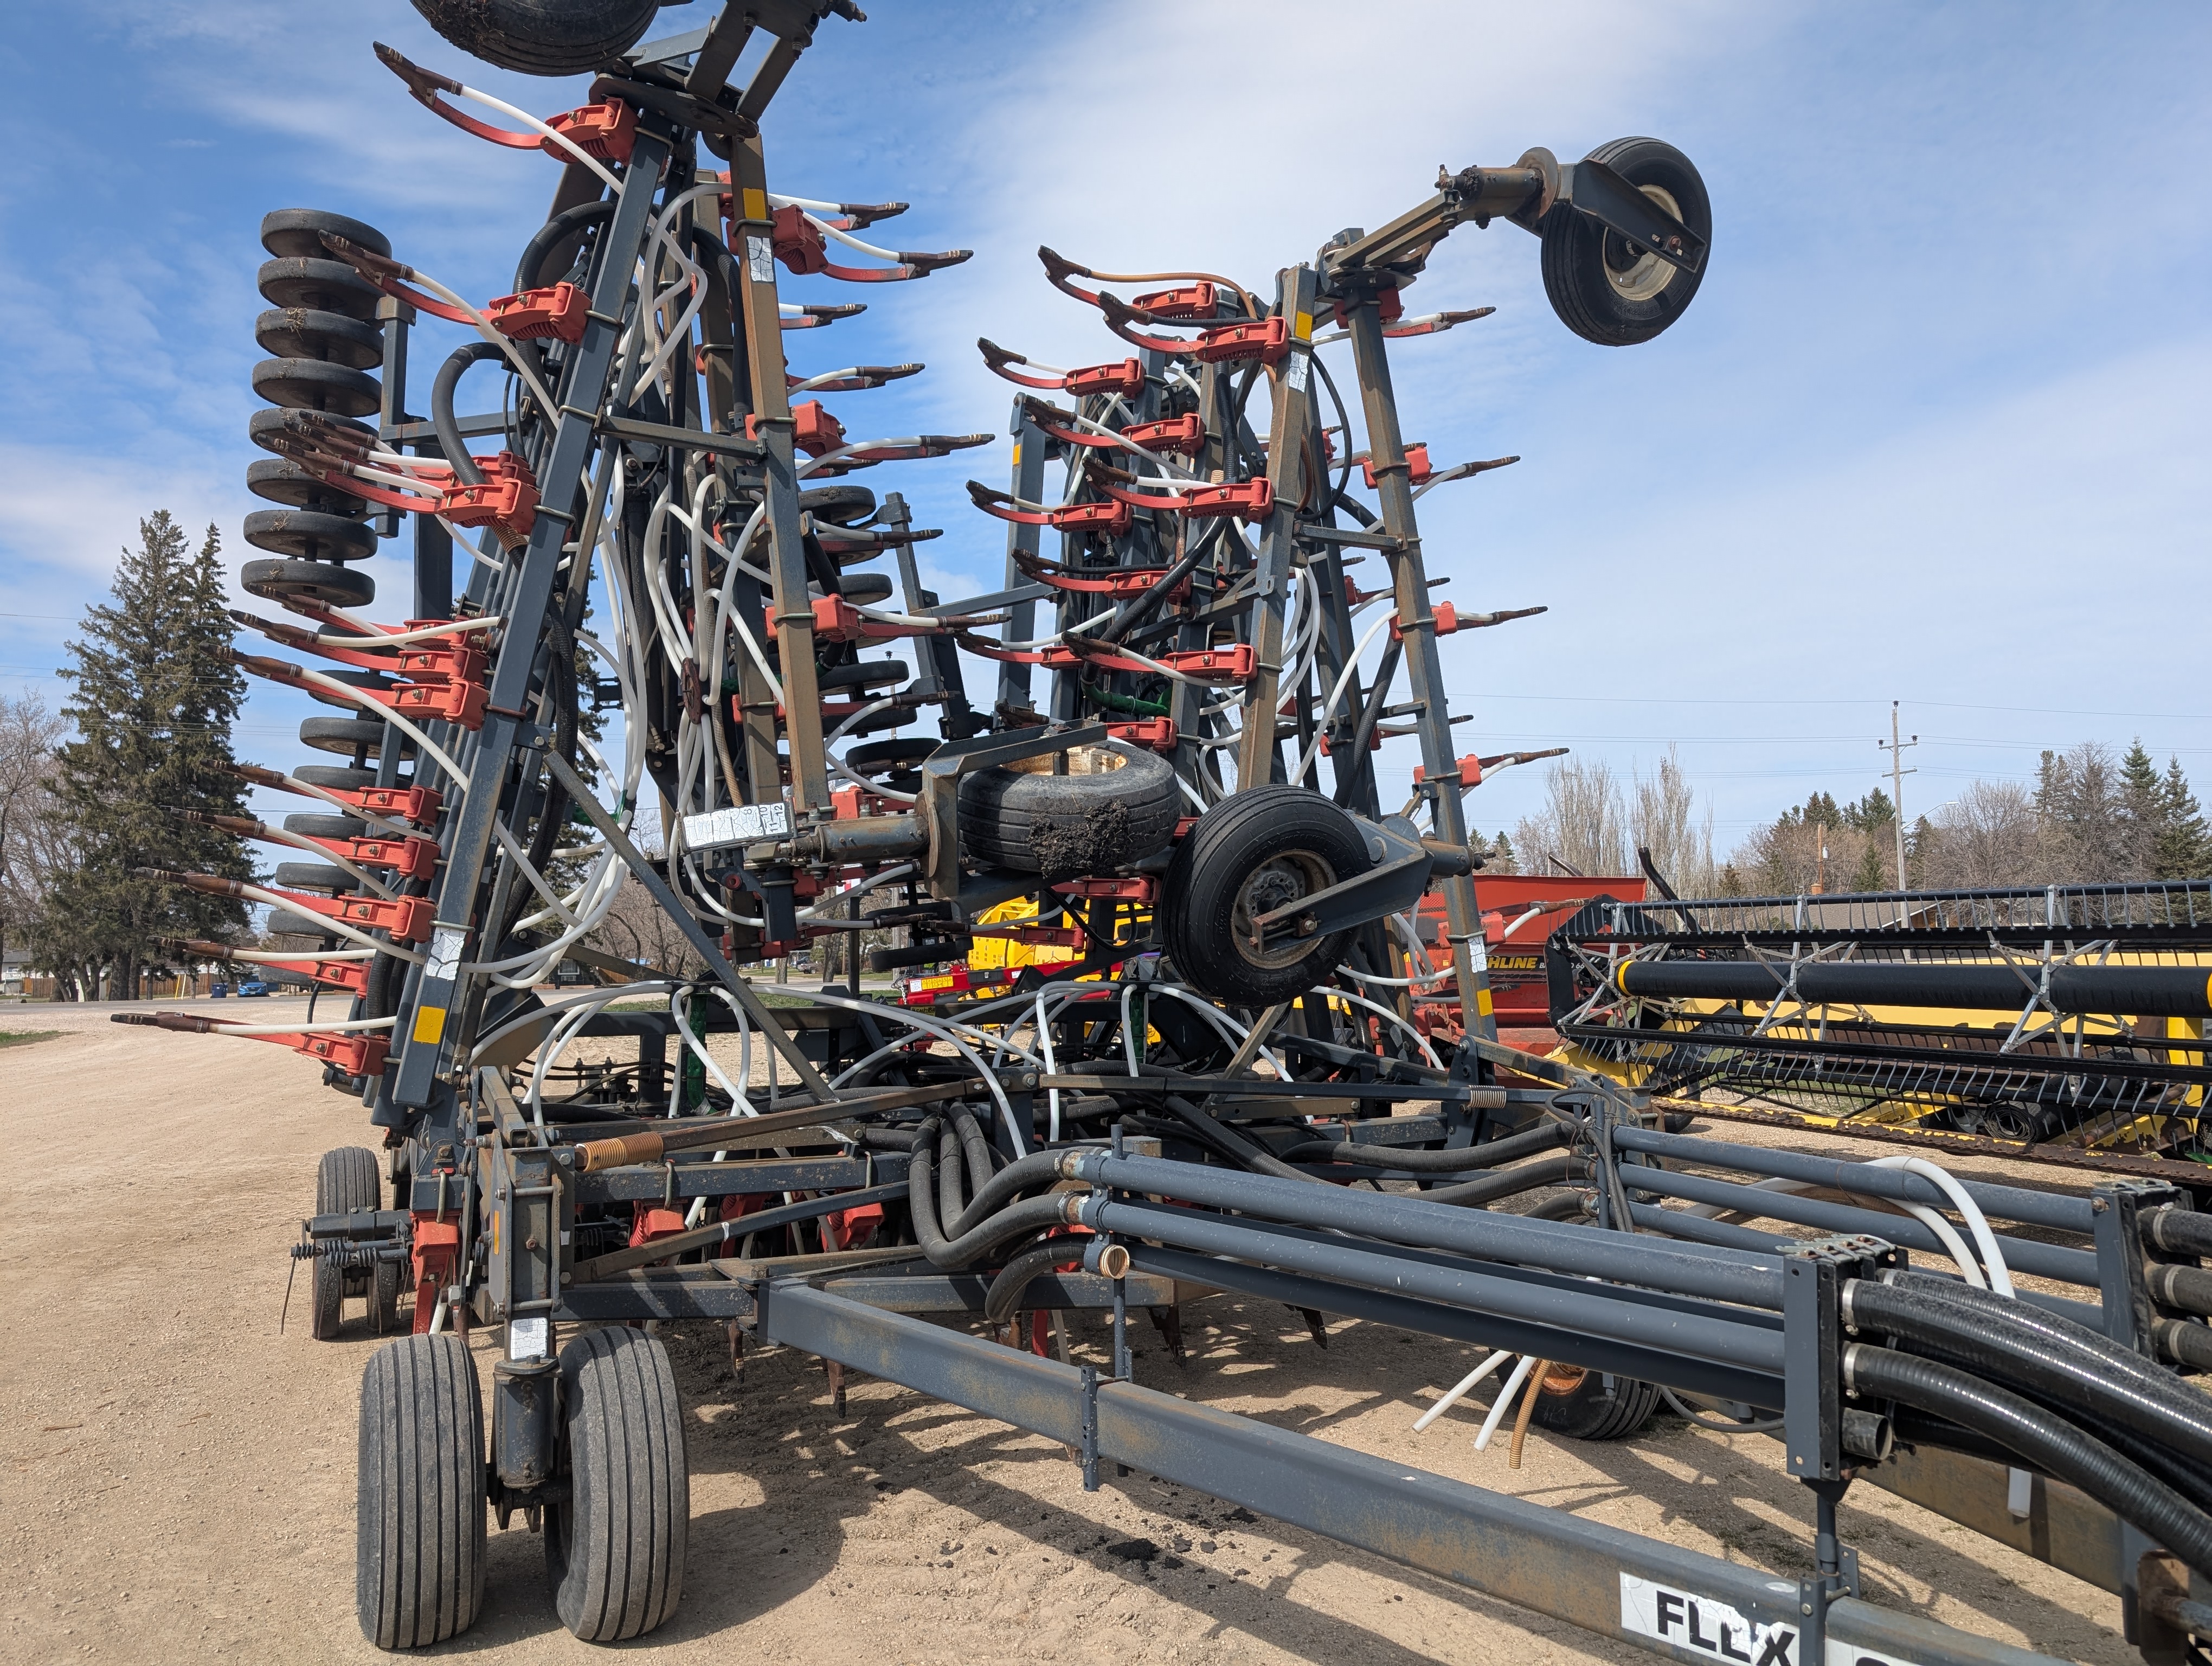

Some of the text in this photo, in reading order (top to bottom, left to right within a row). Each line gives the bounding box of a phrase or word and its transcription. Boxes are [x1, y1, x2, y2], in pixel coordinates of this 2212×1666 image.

[760, 807, 768, 817] 10
[774, 805, 783, 816] 12
[769, 823, 779, 832] 11
[1486, 957, 1538, 969] HLINE
